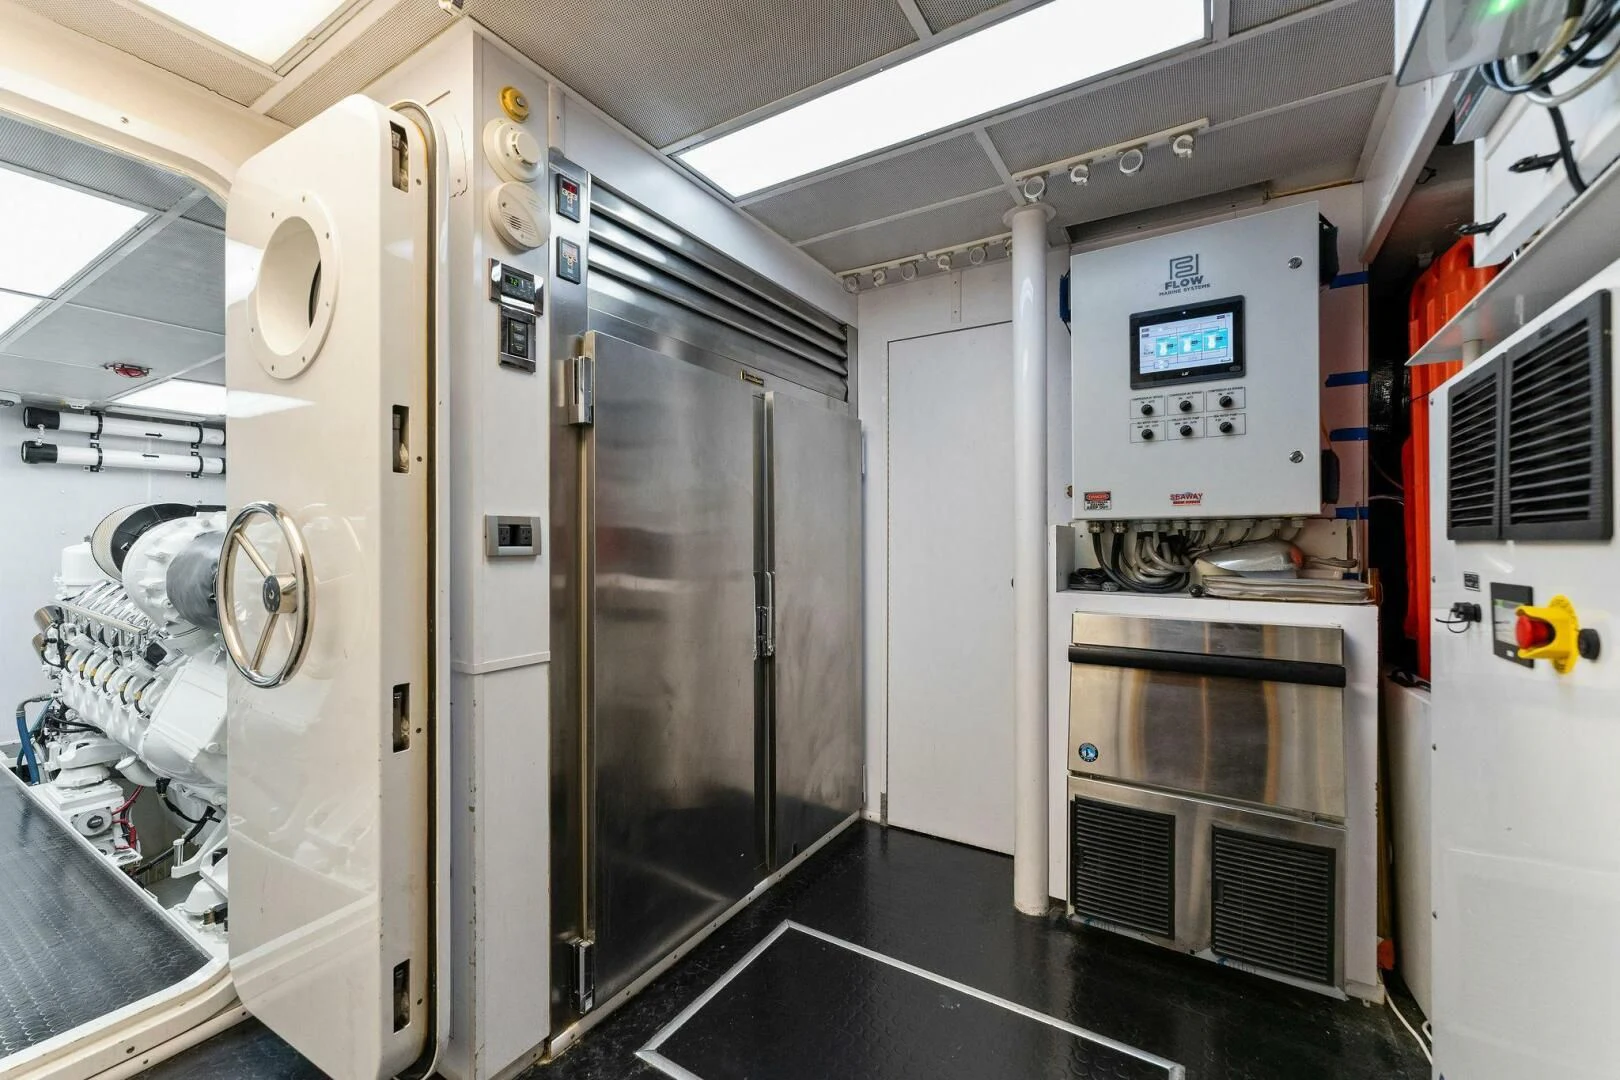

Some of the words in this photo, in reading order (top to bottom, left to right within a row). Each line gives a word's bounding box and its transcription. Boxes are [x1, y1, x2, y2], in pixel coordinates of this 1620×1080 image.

[1165, 275, 1204, 290] FLOW
[1184, 283, 1210, 292] SYSTEMS
[1170, 493, 1203, 501] SEAWAY
